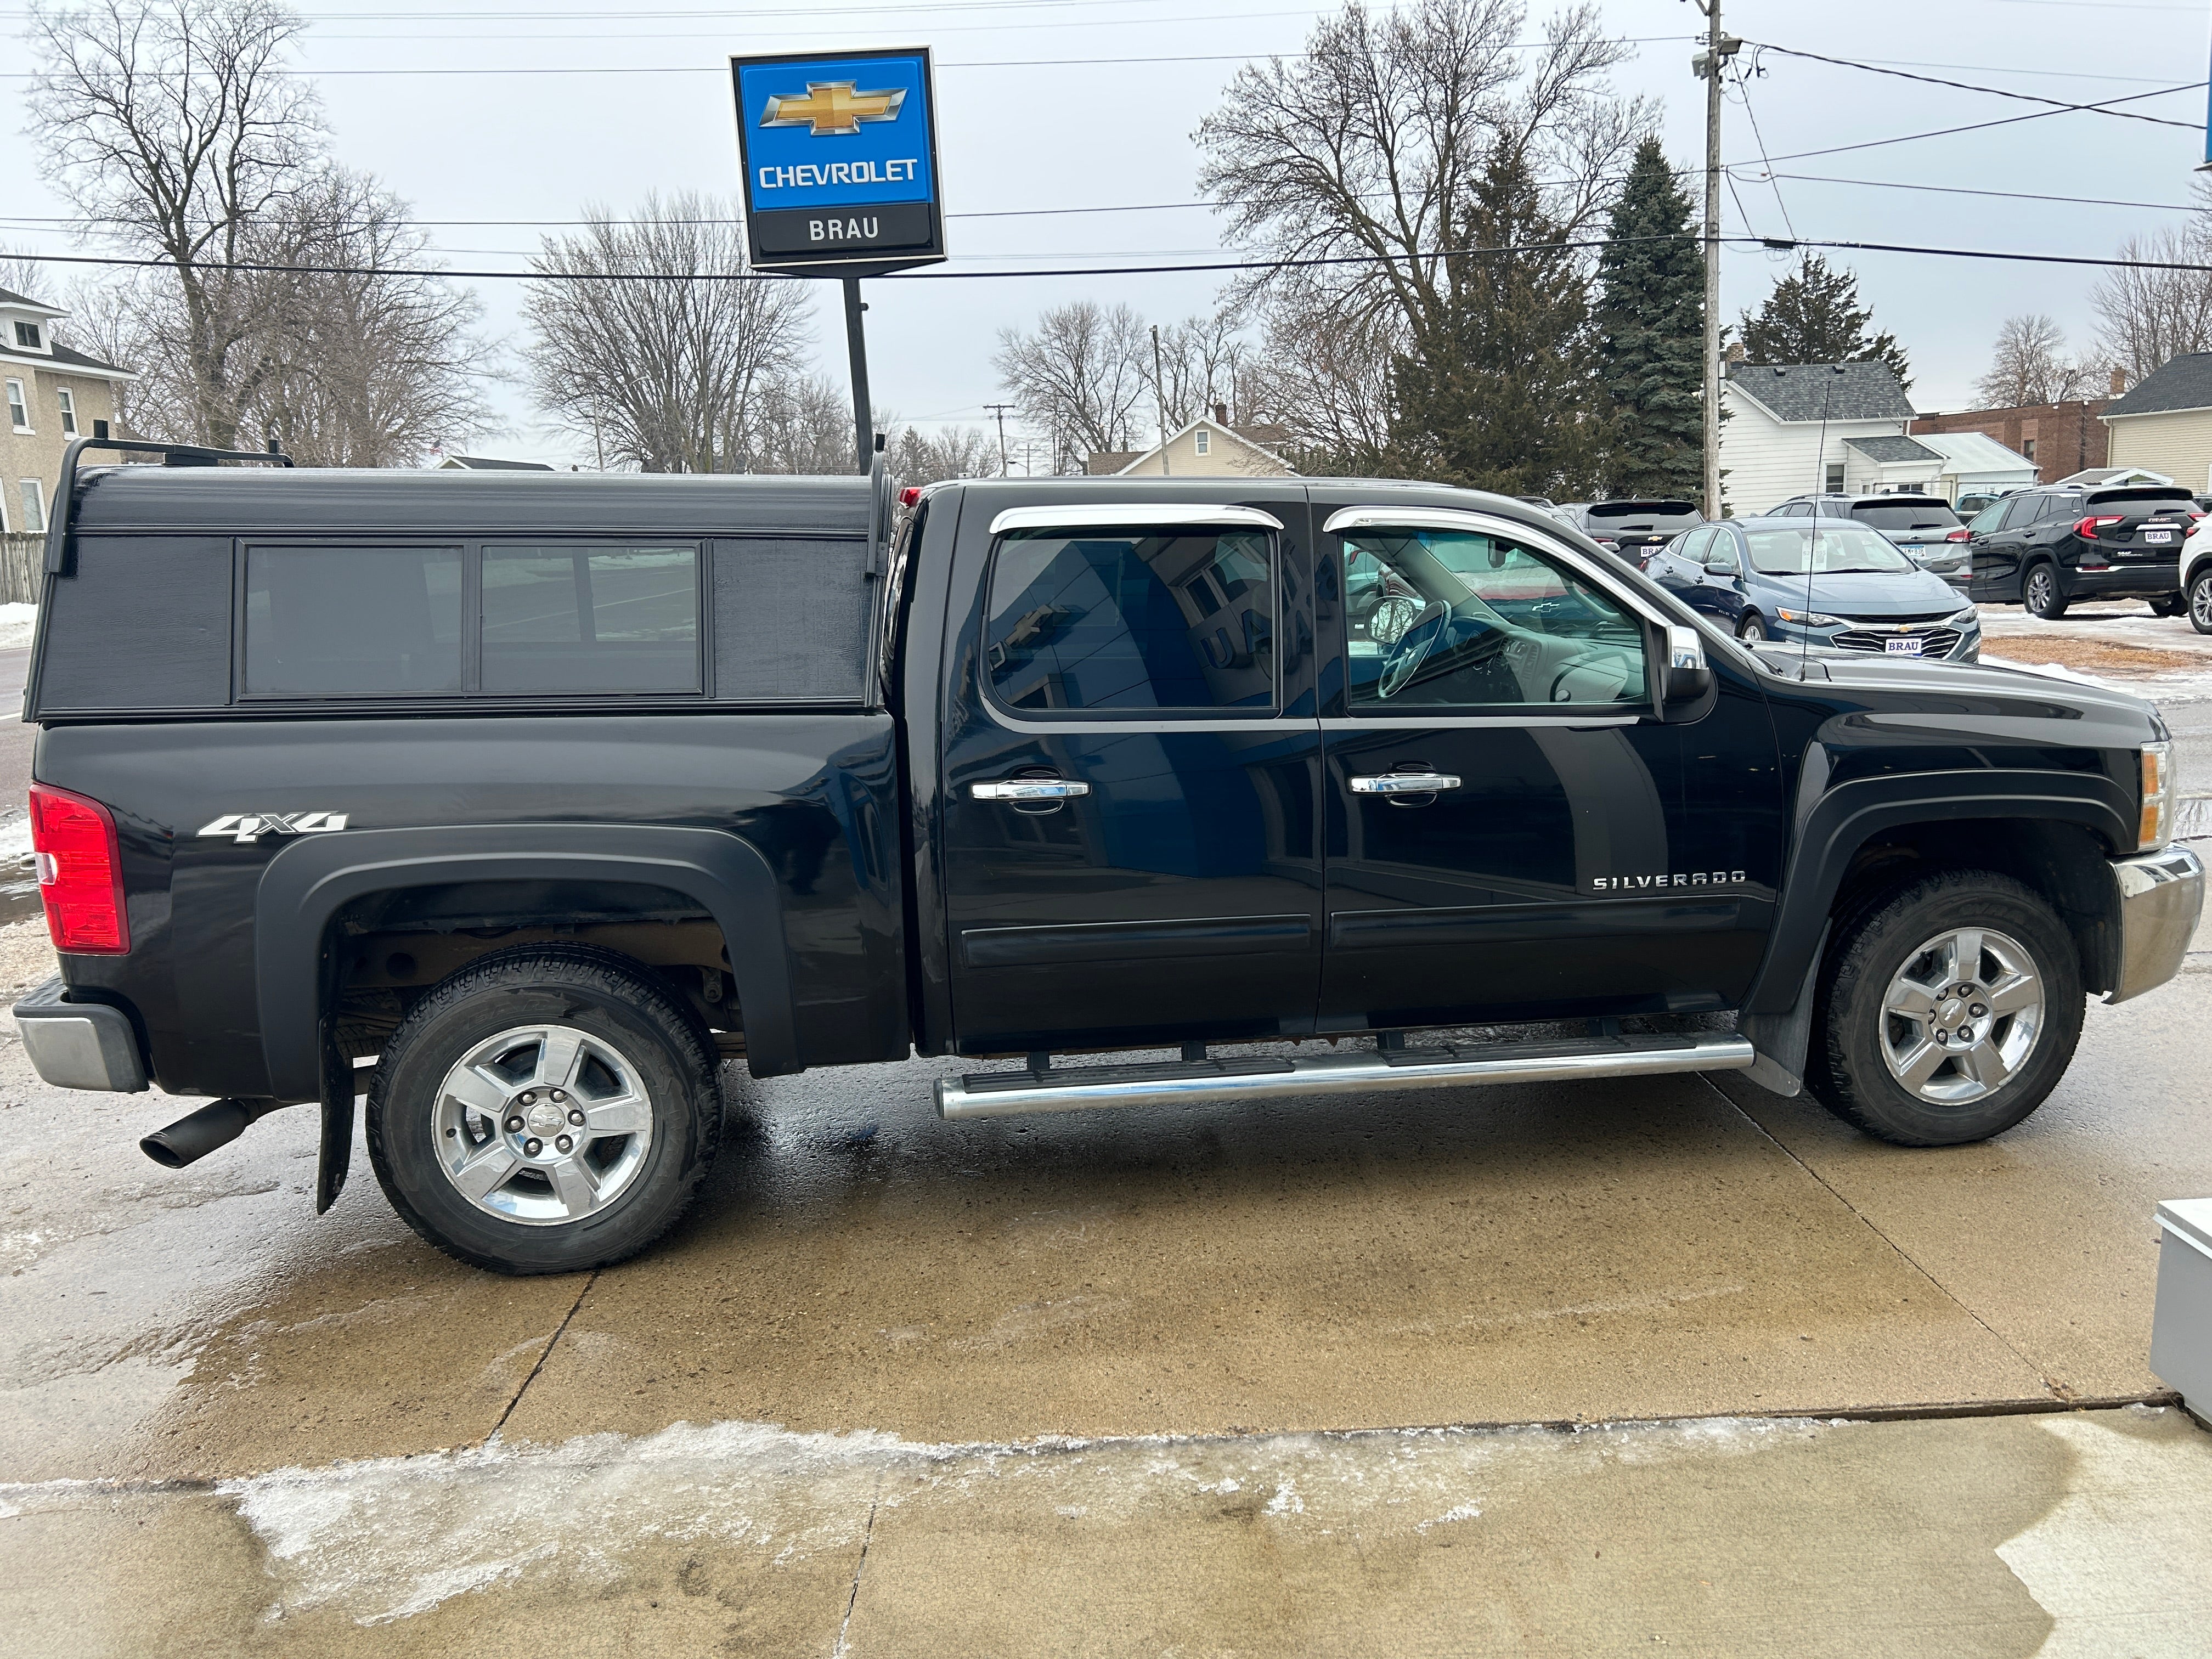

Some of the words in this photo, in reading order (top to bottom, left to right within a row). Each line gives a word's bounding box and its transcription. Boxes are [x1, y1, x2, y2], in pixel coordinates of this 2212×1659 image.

[759, 159, 918, 189] CHEVROLET
[809, 217, 878, 241] BRAU
[1888, 641, 1919, 651] BRAU
[1593, 870, 1746, 890] SILVERADO
